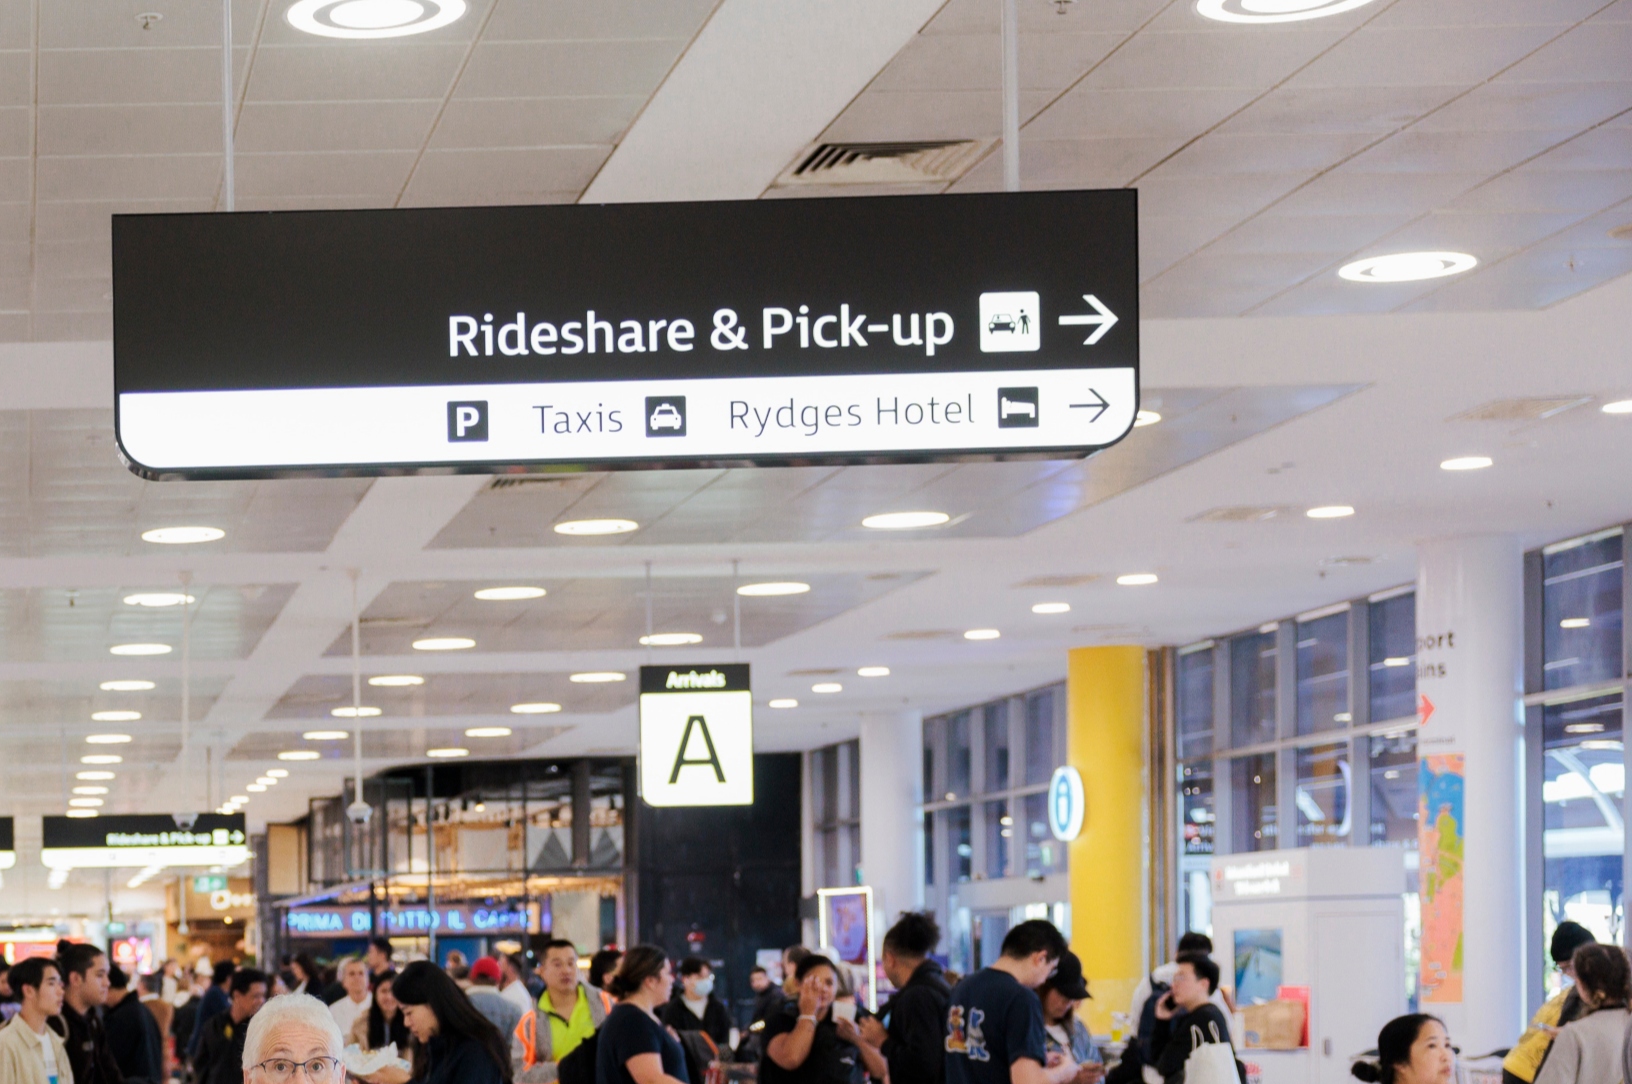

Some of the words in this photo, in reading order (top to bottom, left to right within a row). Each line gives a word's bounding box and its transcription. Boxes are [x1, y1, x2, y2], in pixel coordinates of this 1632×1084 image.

[447, 305, 696, 359] Rideshare
[710, 307, 750, 351] &
[761, 301, 956, 359] Pick-up
[532, 402, 624, 436] Taxis
[729, 396, 862, 438] Rydges
[875, 393, 976, 428] Hotel
[666, 668, 726, 689] Arrivals
[668, 715, 726, 785] A
[287, 911, 344, 932] PRIMA
[351, 911, 372, 931] DI
[447, 910, 467, 930] IL
